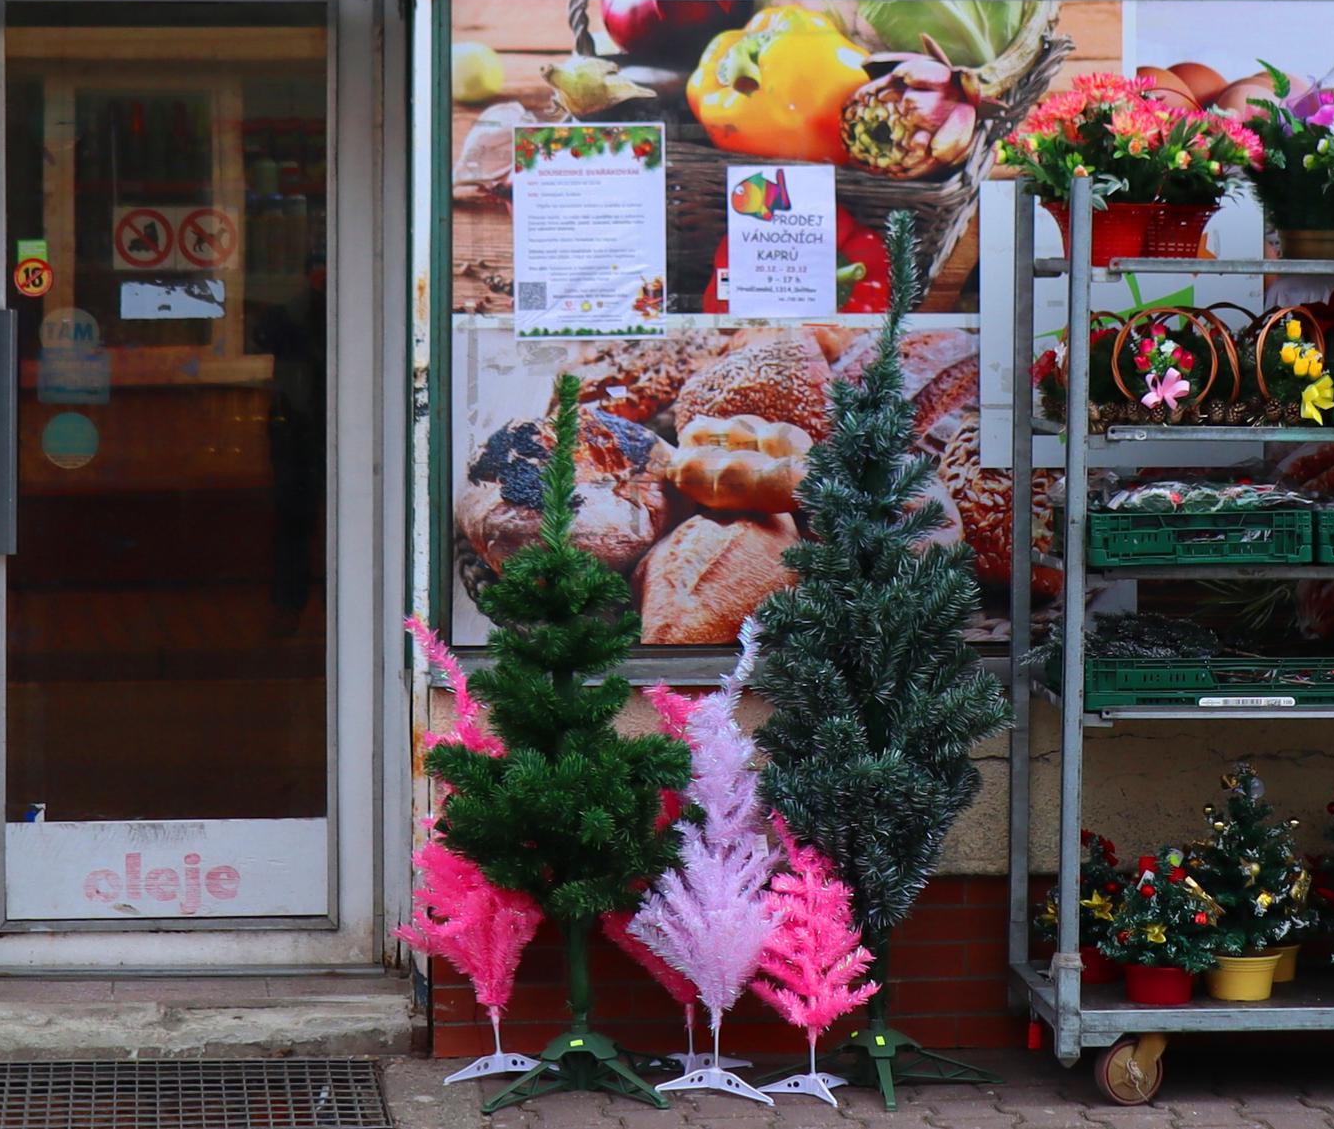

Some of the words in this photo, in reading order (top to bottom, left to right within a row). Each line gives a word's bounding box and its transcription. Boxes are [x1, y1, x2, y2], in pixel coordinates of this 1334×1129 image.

[772, 214, 825, 227] PRODEJ
[742, 228, 824, 244] VÁNOČNÍCH
[757, 247, 799, 262] KAPRŮ
[45, 323, 93, 340] TAM
[82, 853, 242, 915] oleje
